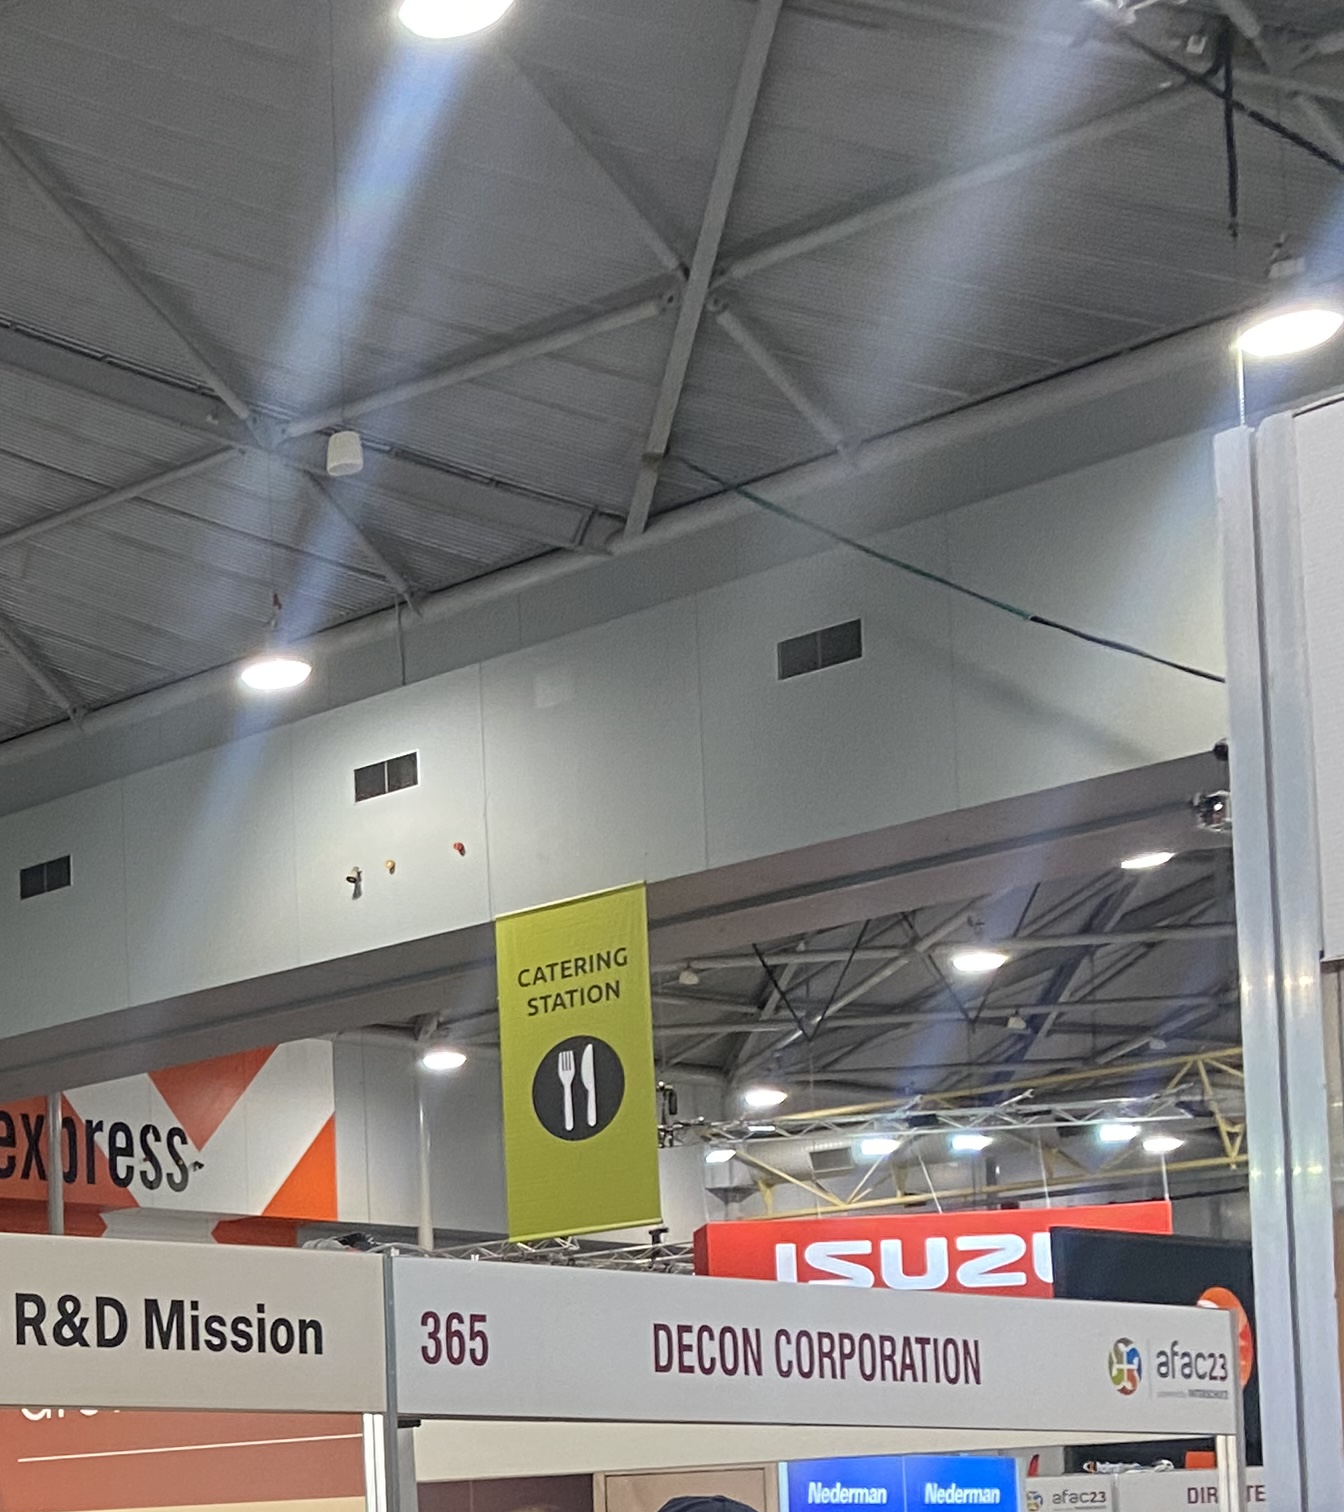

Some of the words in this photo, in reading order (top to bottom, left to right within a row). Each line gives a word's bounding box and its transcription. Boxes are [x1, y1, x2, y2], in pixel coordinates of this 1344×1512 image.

[516, 946, 630, 988] CATERING
[526, 980, 622, 1017] STATION
[14, 1291, 128, 1349] R&D
[143, 1298, 325, 1356] Mission
[419, 1311, 490, 1367] 365
[652, 1323, 764, 1378] DECON
[773, 1328, 982, 1386] CORPORATION
[1156, 1340, 1229, 1382] afac23
[807, 1482, 888, 1504] Nederman
[924, 1483, 1002, 1504] Nederman
[1052, 1489, 1107, 1506] afac23
